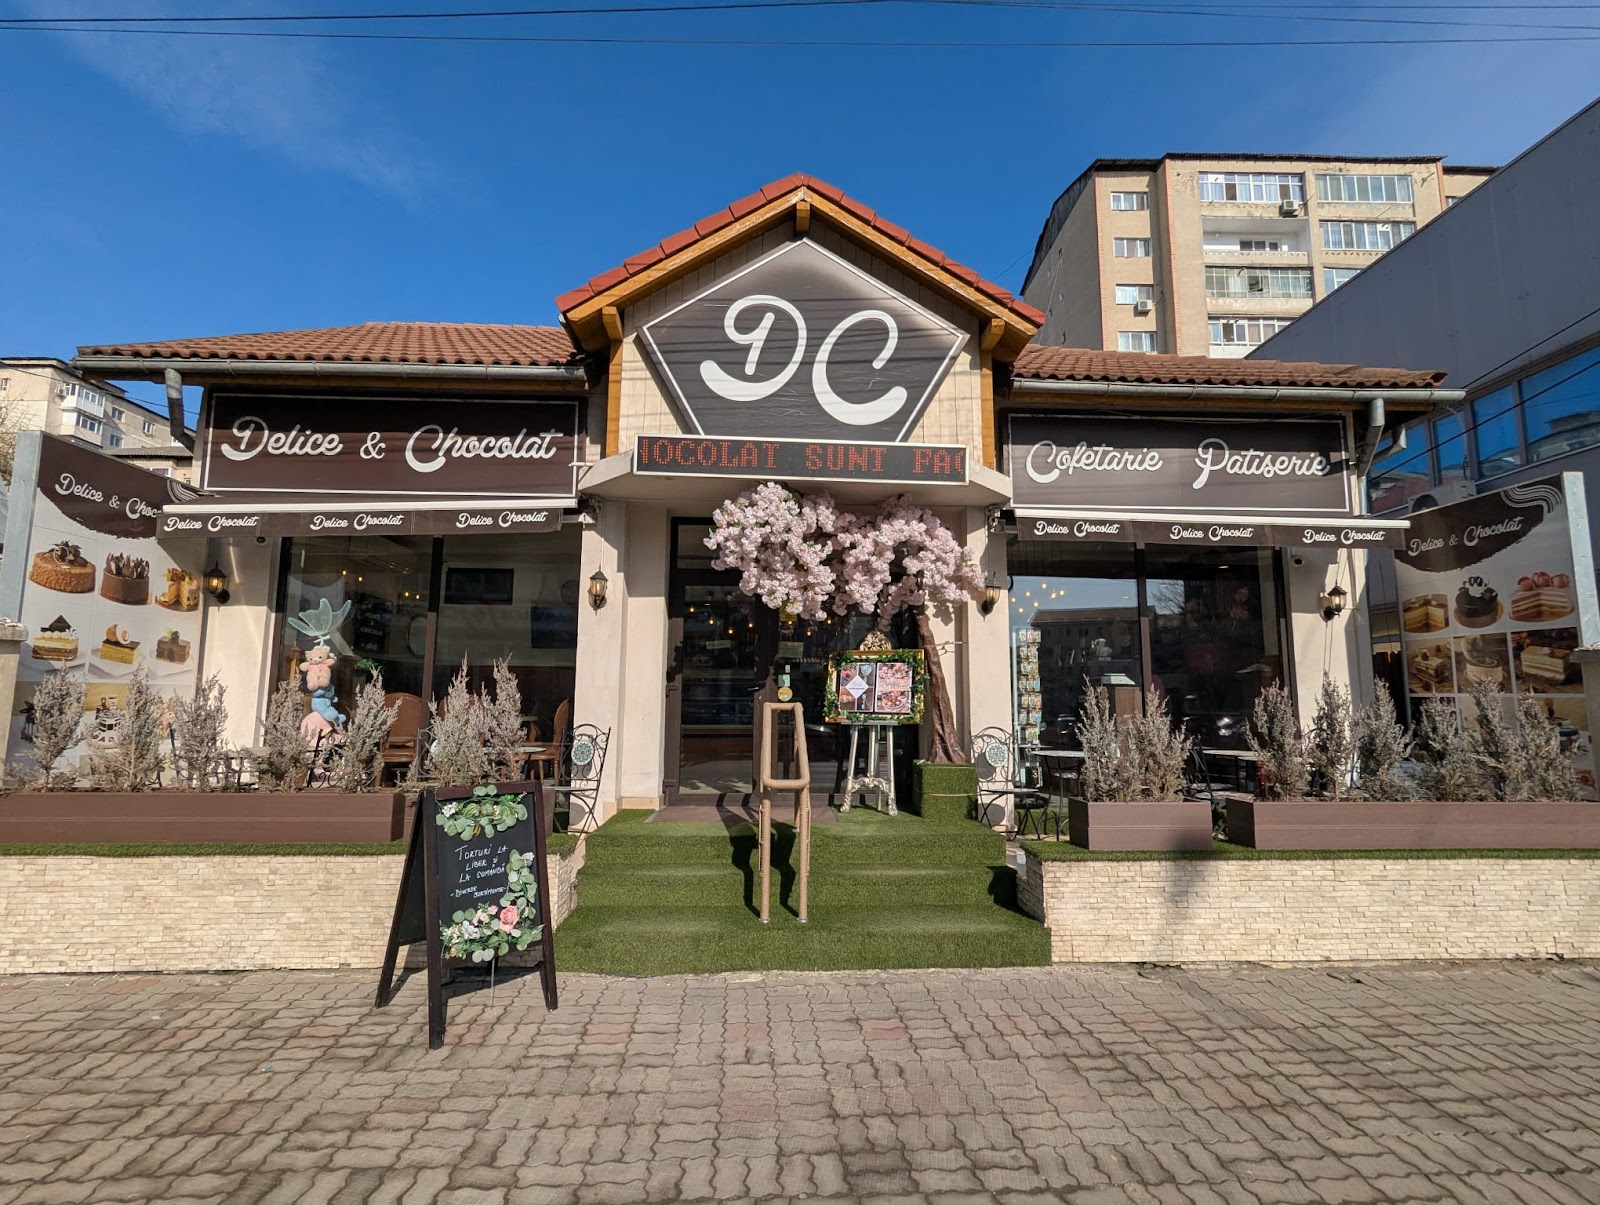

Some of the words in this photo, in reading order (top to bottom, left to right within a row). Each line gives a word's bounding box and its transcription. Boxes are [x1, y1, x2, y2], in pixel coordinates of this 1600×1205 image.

[221, 416, 343, 461] Delice
[360, 431, 386, 459] &
[405, 424, 564, 473] Chocolat
[805, 444, 887, 473] SUNT
[1026, 440, 1163, 484] Cofetarie
[1192, 438, 1331, 490] Patiserie
[55, 473, 104, 502] Delice
[109, 495, 120, 509] &
[163, 516, 202, 532] Delice
[207, 515, 260, 532] Chocolat
[310, 515, 348, 531] Delice
[353, 513, 405, 531] Chocolat
[455, 512, 494, 528] Delice
[498, 511, 549, 528] Chocolat
[1033, 520, 1069, 536] Delice
[1073, 521, 1120, 537] Chocolat
[1169, 525, 1204, 540] Delice
[1208, 525, 1254, 541] Chocolat
[1302, 529, 1337, 544] Delice
[1340, 529, 1386, 545] Chocolat
[1408, 538, 1444, 557] Delice
[1448, 534, 1459, 547] &
[1463, 516, 1524, 546] Chocolat
